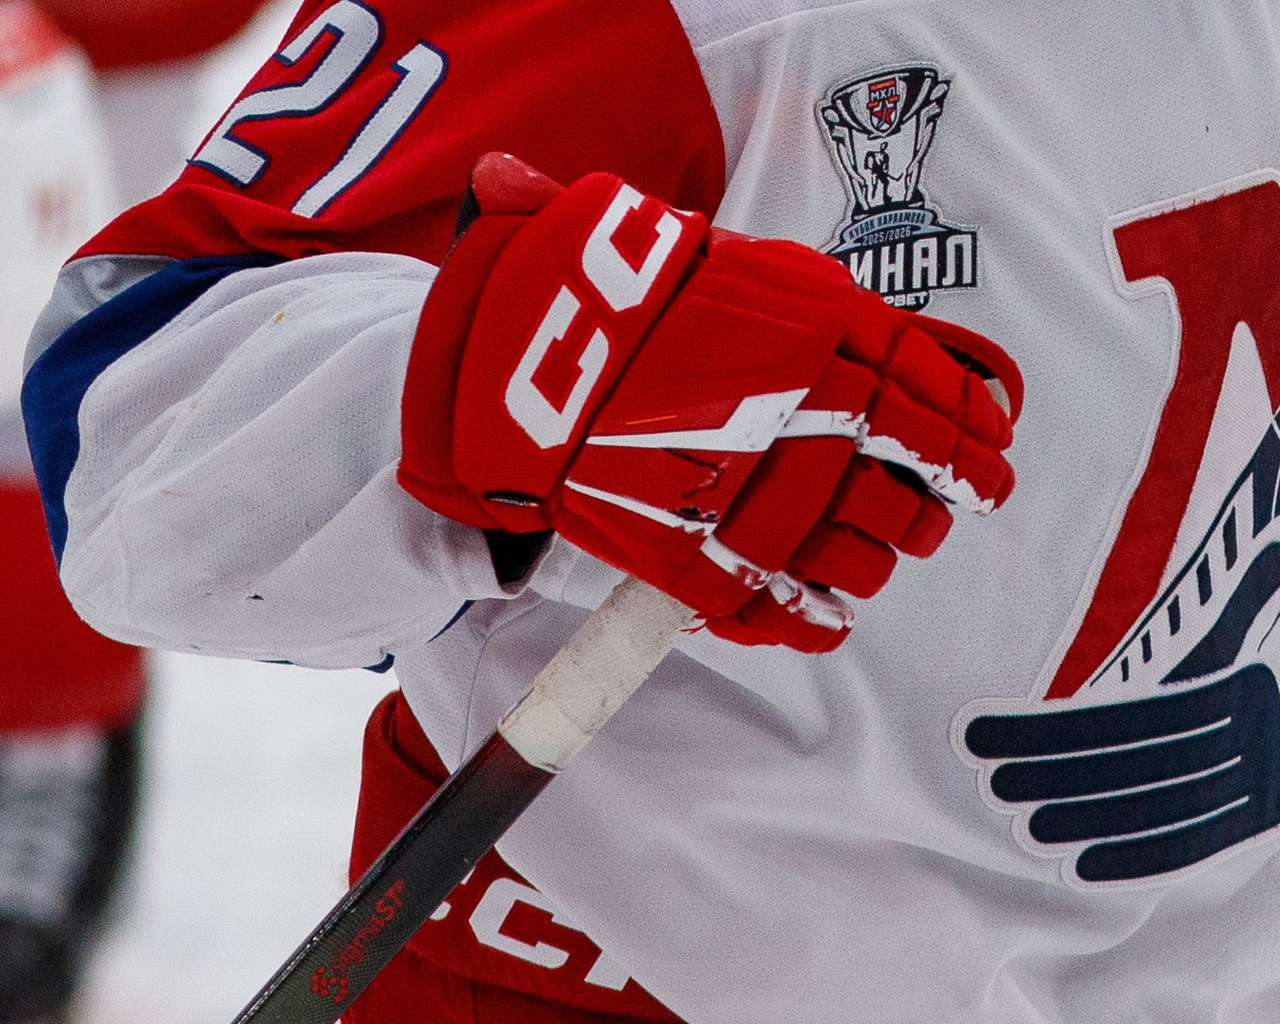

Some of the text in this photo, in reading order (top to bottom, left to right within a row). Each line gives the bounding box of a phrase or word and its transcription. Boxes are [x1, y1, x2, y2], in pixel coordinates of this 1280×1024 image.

[871, 86, 896, 101] МХЛ
[862, 226, 911, 246] 2025/2026
[848, 234, 972, 294] ИНАЛ
[504, 183, 690, 449] CC
